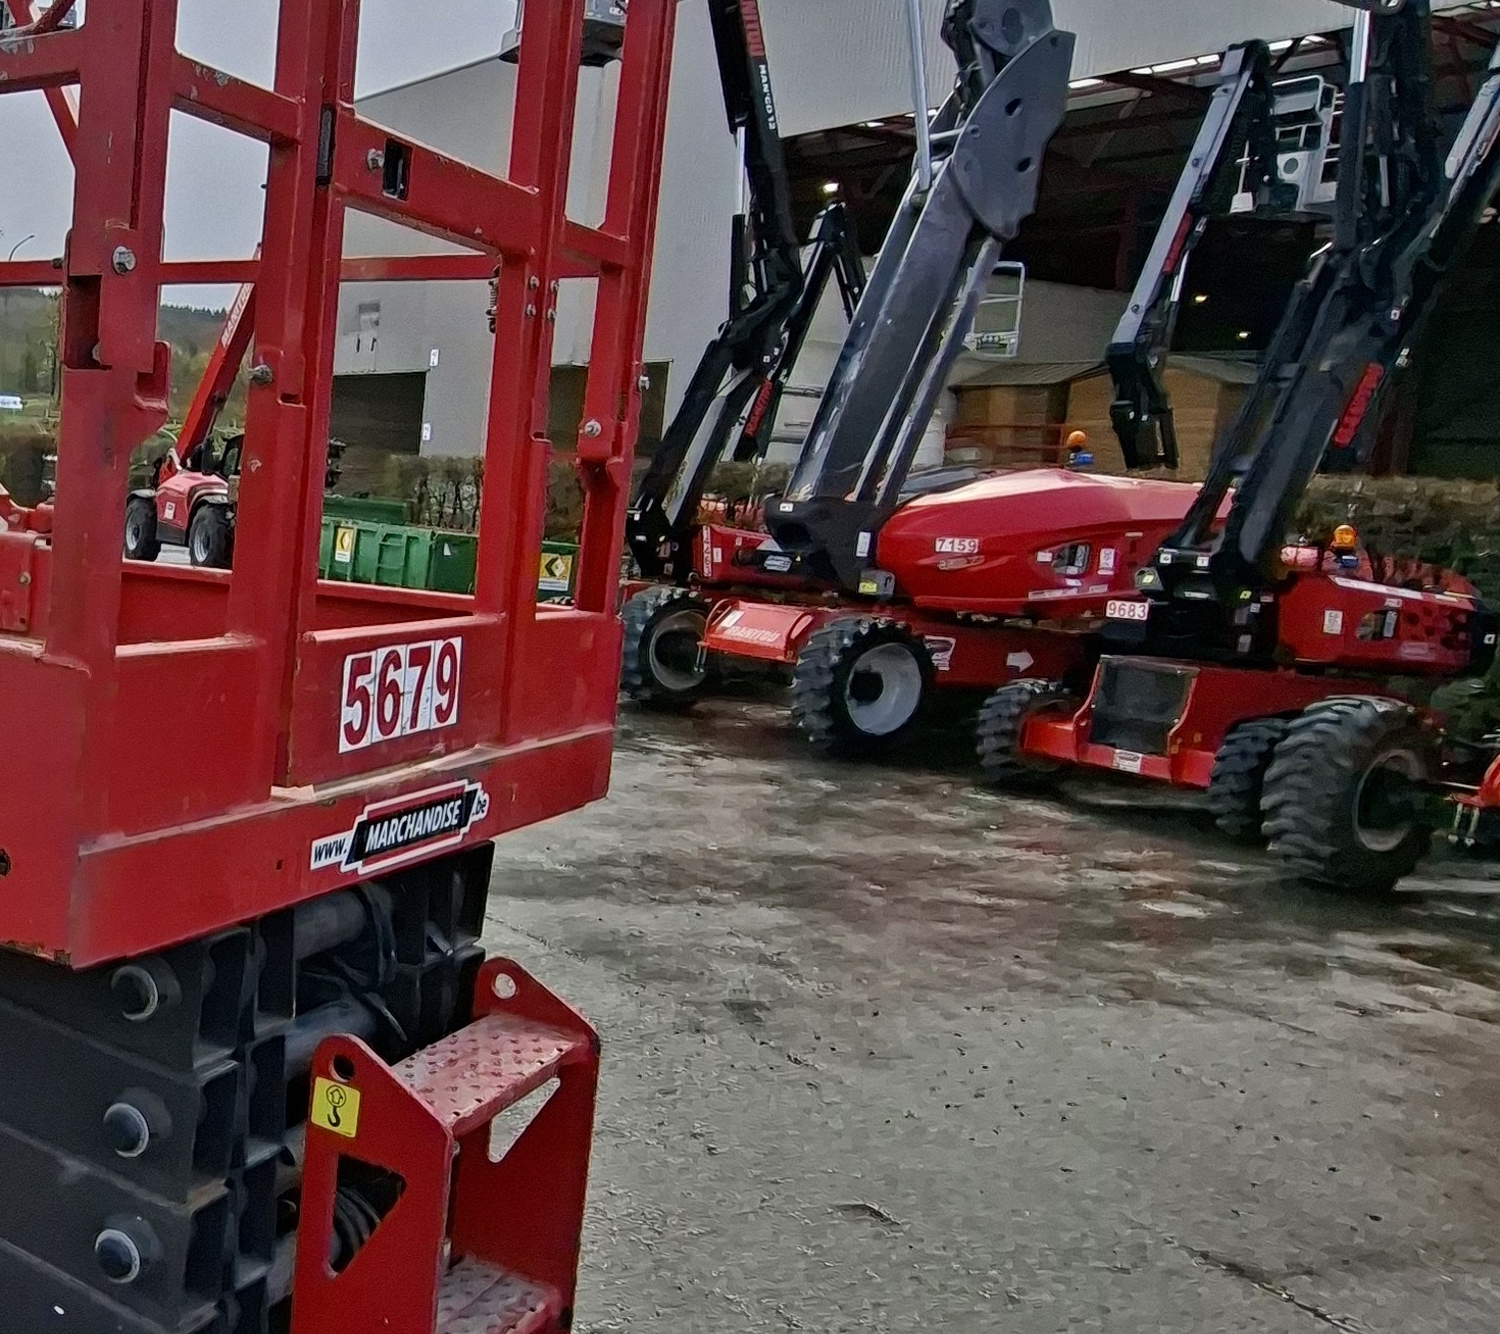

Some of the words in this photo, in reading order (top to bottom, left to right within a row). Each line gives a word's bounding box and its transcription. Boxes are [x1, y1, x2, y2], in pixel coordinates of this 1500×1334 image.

[936, 537, 978, 552] 7159
[1107, 601, 1147, 619] 9683
[343, 642, 459, 746] 5679
[365, 798, 463, 854] MARCHANDISE
